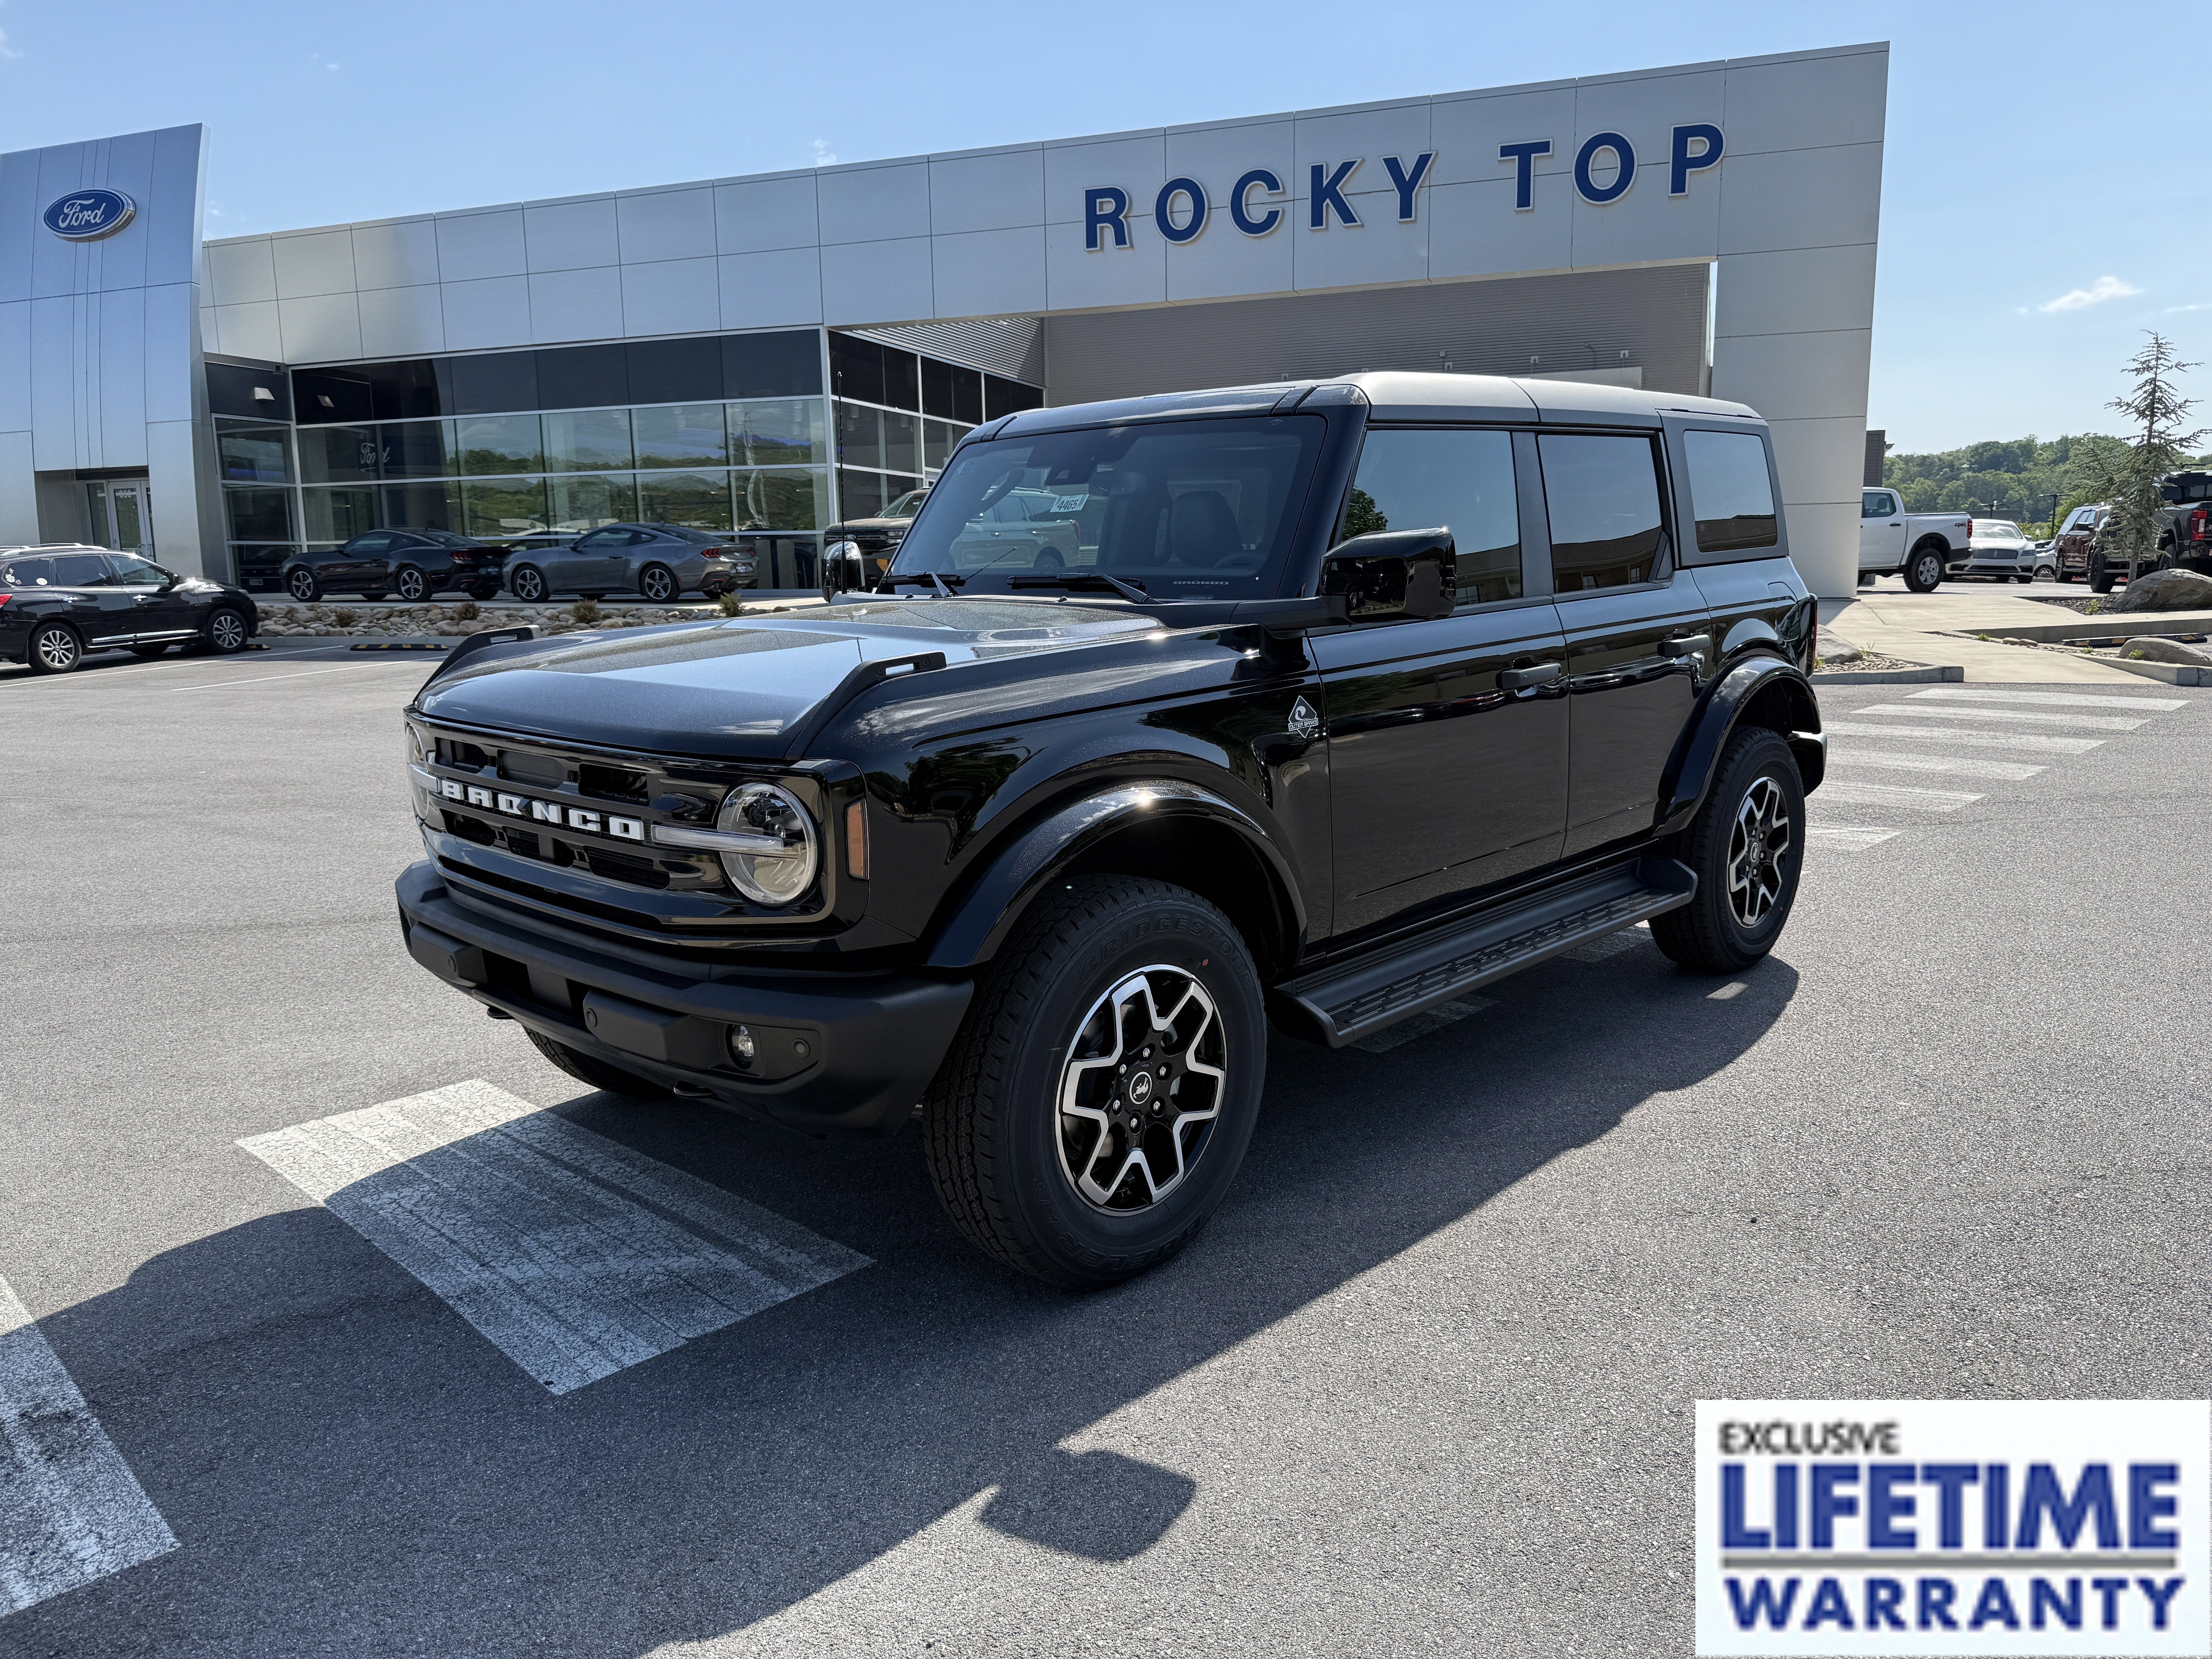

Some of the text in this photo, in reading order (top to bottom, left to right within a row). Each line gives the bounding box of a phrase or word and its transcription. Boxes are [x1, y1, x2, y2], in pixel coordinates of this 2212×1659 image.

[58, 198, 106, 228] Ford
[1083, 122, 1726, 251] ROCKY TOP
[360, 443, 390, 464] Ford
[1057, 499, 1079, 510] 4465
[441, 779, 644, 841] BRONCO
[1079, 914, 1254, 989] BRIDGESTONE
[1056, 1212, 1201, 1270] DUELER
